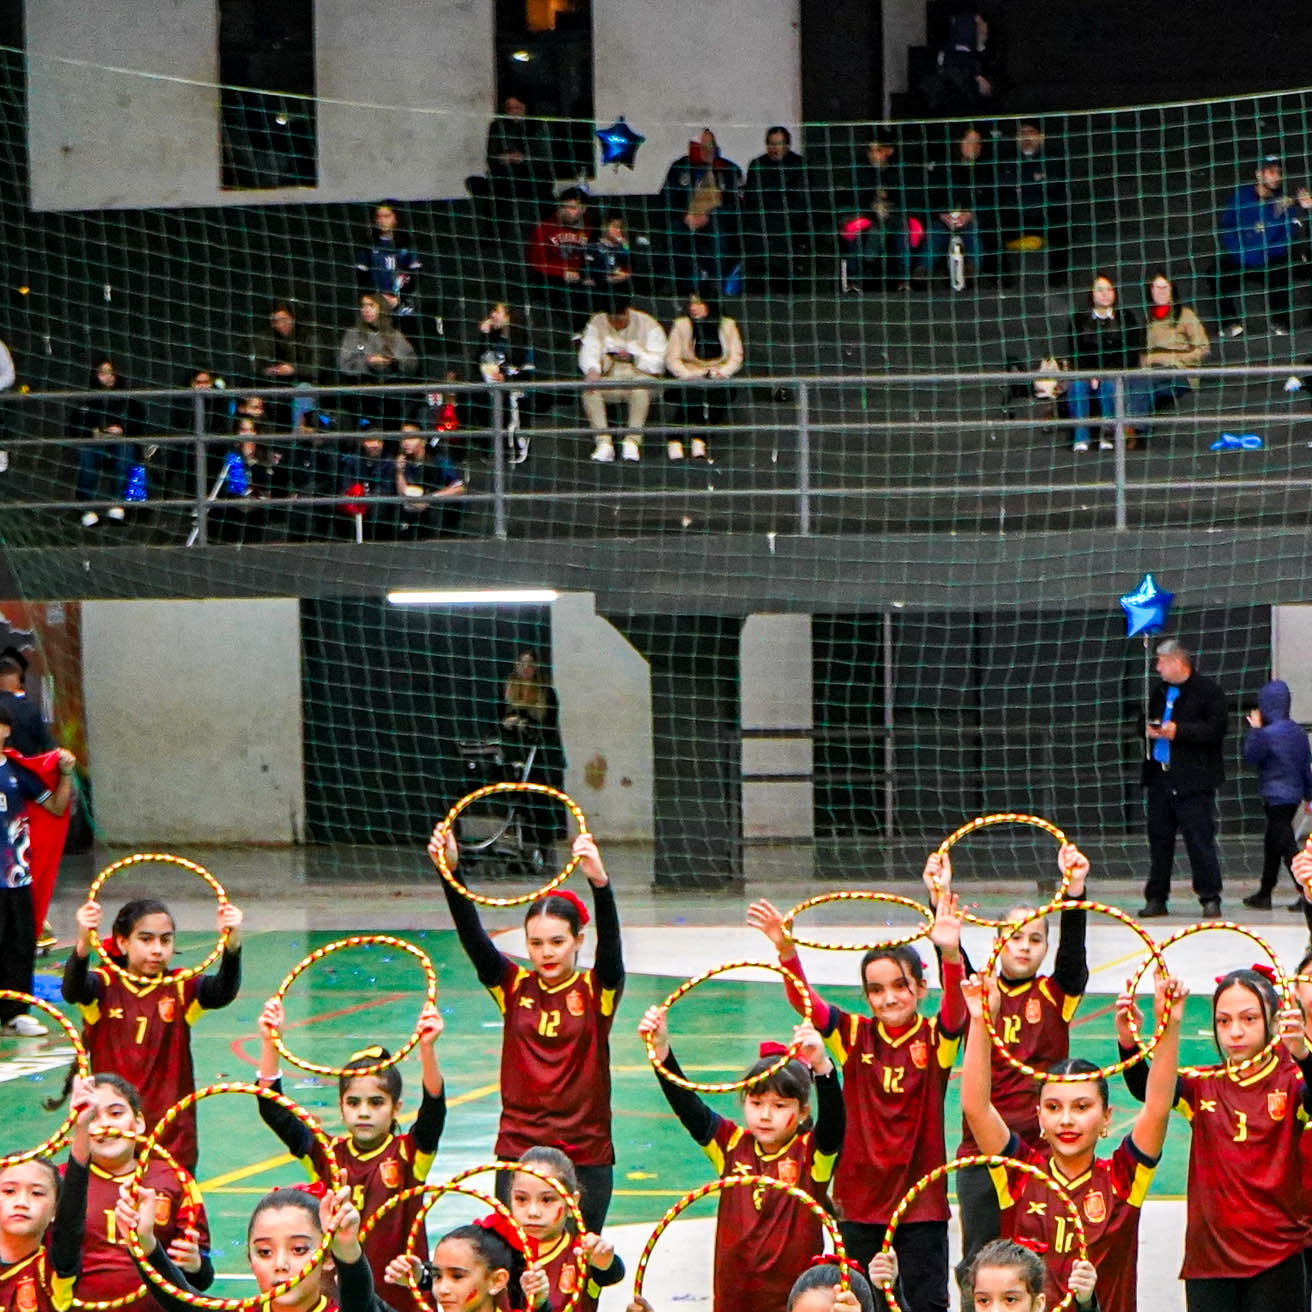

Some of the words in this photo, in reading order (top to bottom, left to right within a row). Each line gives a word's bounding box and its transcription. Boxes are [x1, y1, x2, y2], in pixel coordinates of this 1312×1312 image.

[135, 1016, 148, 1044] 7
[538, 1010, 561, 1037] 12
[1002, 1015, 1021, 1043] 12
[882, 1065, 905, 1093] 12
[1232, 1110, 1248, 1142] 3
